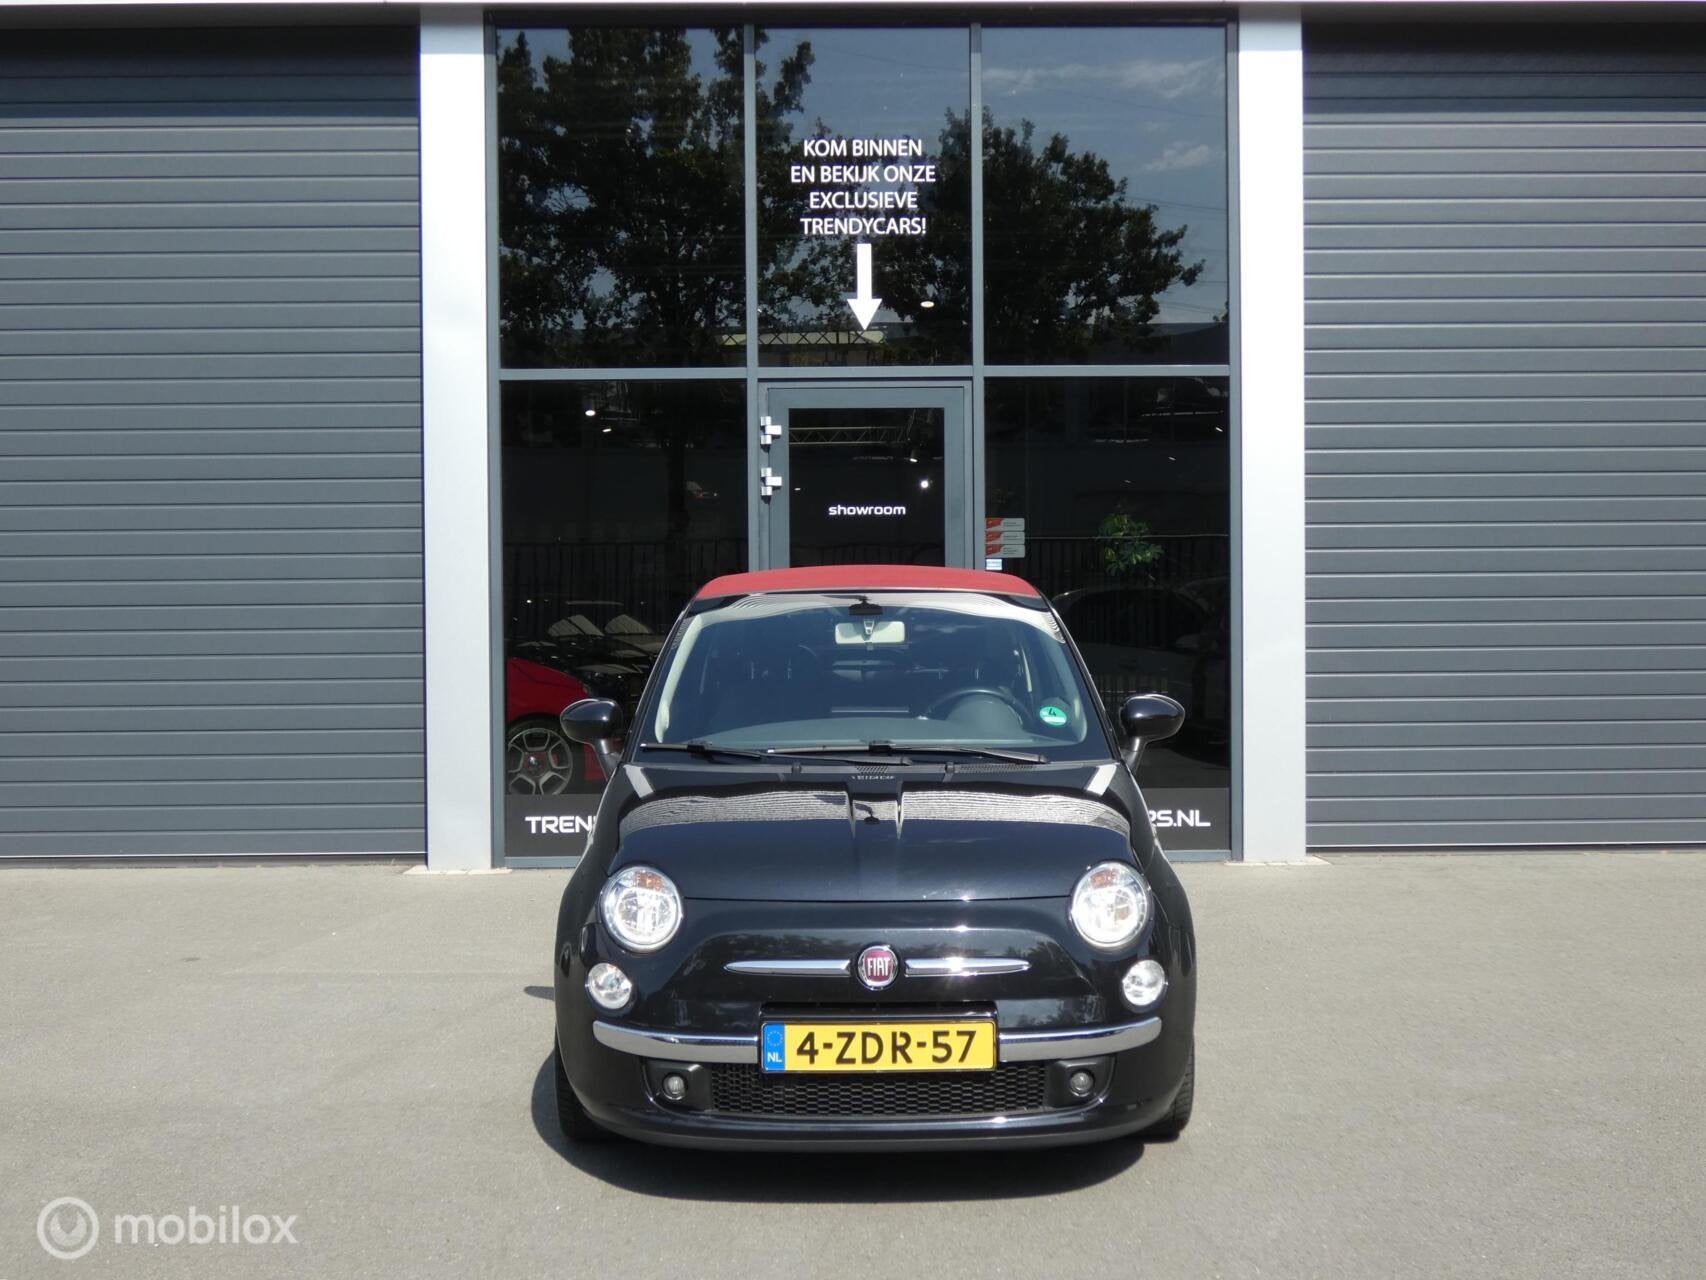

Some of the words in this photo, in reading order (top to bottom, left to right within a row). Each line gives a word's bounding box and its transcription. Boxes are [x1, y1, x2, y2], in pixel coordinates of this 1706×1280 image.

[803, 139, 847, 157] KOM
[852, 139, 922, 157] BINNEN
[790, 165, 816, 183] EN
[820, 165, 880, 183] BEKIJK
[883, 165, 936, 183] ONZE
[809, 191, 918, 209] EXCLUSIEVE
[800, 217, 927, 235] TRENDYCARS!
[828, 504, 906, 516] showroom
[525, 815, 598, 834] TREN
[867, 957, 891, 977] FIAT
[796, 1030, 977, 1065] 4-ZDR-57
[767, 1053, 783, 1063] NL
